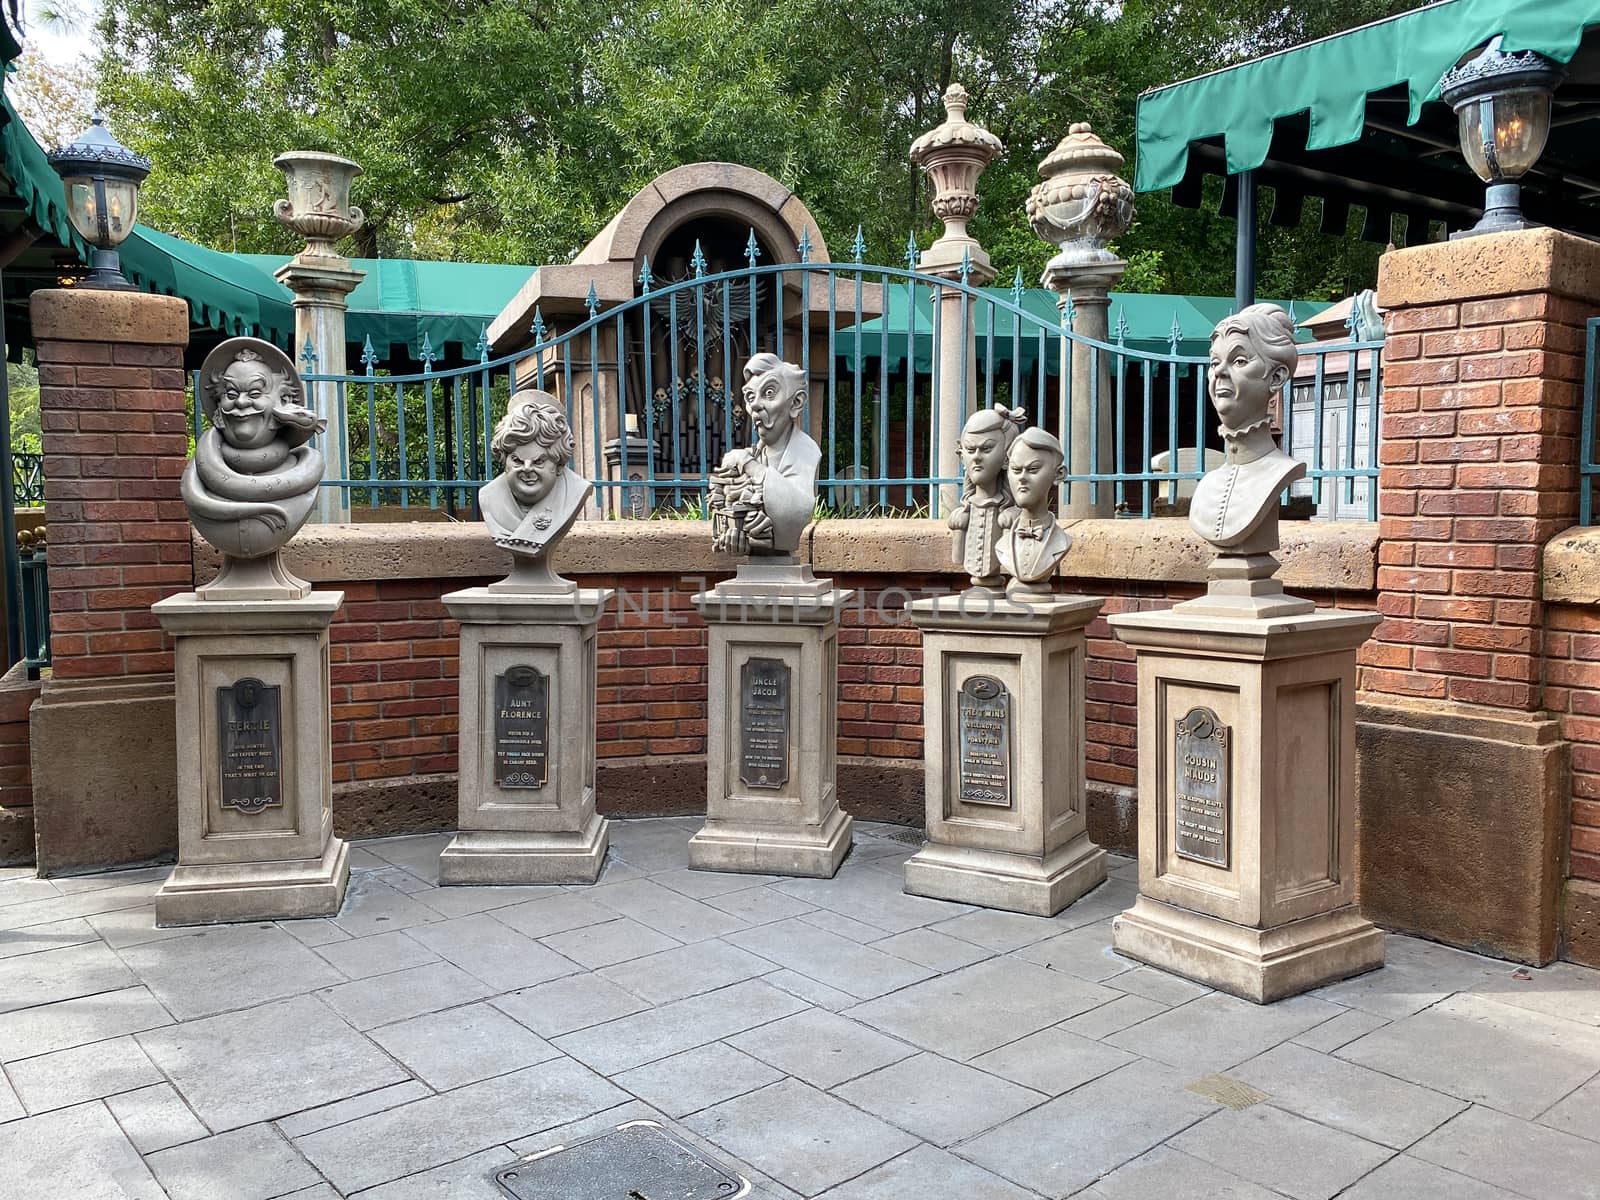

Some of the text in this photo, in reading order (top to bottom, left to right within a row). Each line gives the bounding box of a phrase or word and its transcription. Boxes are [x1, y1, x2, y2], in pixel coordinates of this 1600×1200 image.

[752, 688, 777, 696] JACOB
[510, 699, 532, 708] AUNT
[501, 710, 542, 719] FLORENCE
[961, 708, 1005, 718] THE TWINS
[965, 721, 1001, 730] WELLINGTON
[1184, 754, 1216, 770] COUSIN
[1184, 767, 1216, 783] MAUDE
